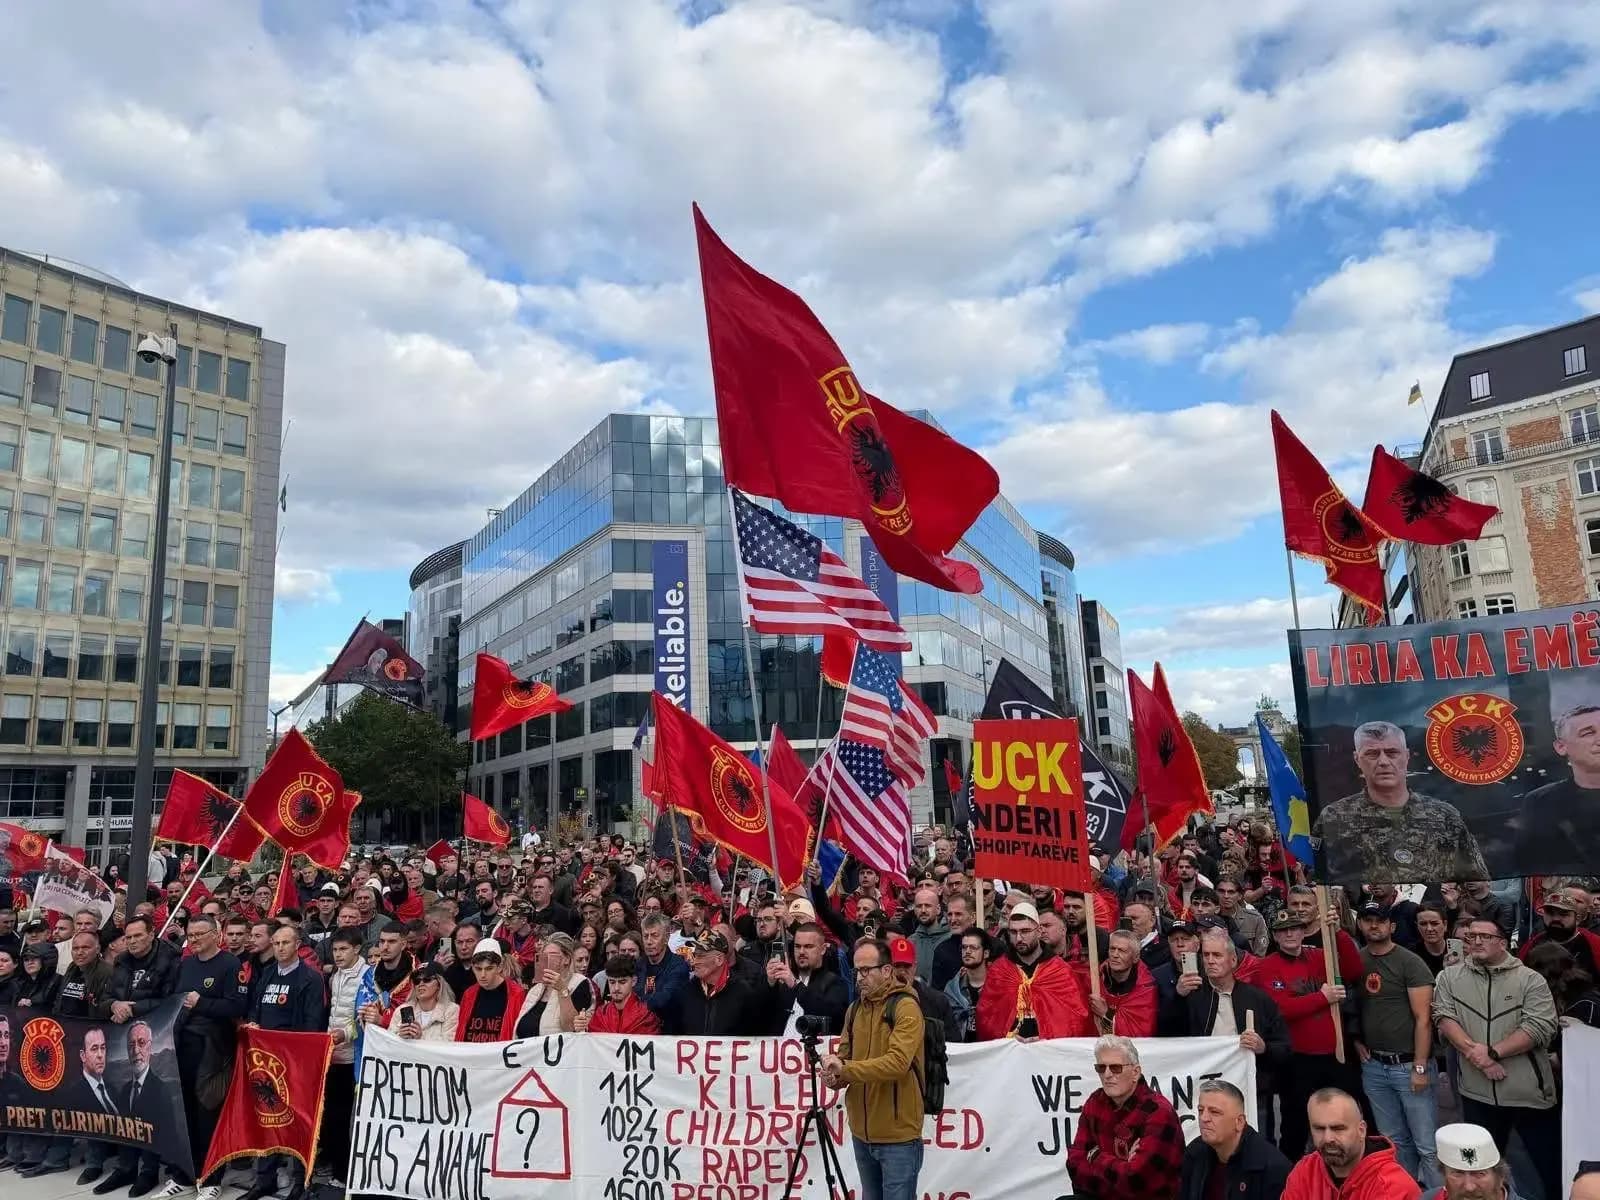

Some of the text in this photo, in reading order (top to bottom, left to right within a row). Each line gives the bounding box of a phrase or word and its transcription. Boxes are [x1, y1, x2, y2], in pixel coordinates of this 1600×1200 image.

[1305, 640, 1424, 688] LIRIA
[1431, 633, 1495, 680] KA
[1432, 696, 1507, 723] UÇK
[1431, 725, 1444, 764] USHTRIA
[1505, 720, 1520, 764] KOSOVES
[974, 741, 1073, 805] UÇK
[1069, 810, 1078, 841] I
[975, 837, 1080, 864] SHQIPTARËVE
[469, 1016, 501, 1031] JO NË
[616, 1039, 656, 1072] 1M
[357, 1056, 472, 1128] FREEDOM
[599, 1071, 654, 1107] 11K
[1032, 1074, 1083, 1113] WE
[6, 1106, 154, 1144] PRET ÇLIRIMTARËT
[600, 1105, 658, 1144] 1024
[665, 1108, 843, 1147] CHILDREN
[349, 1121, 404, 1191] HAS
[622, 1144, 813, 1184] 20K RAPED.
